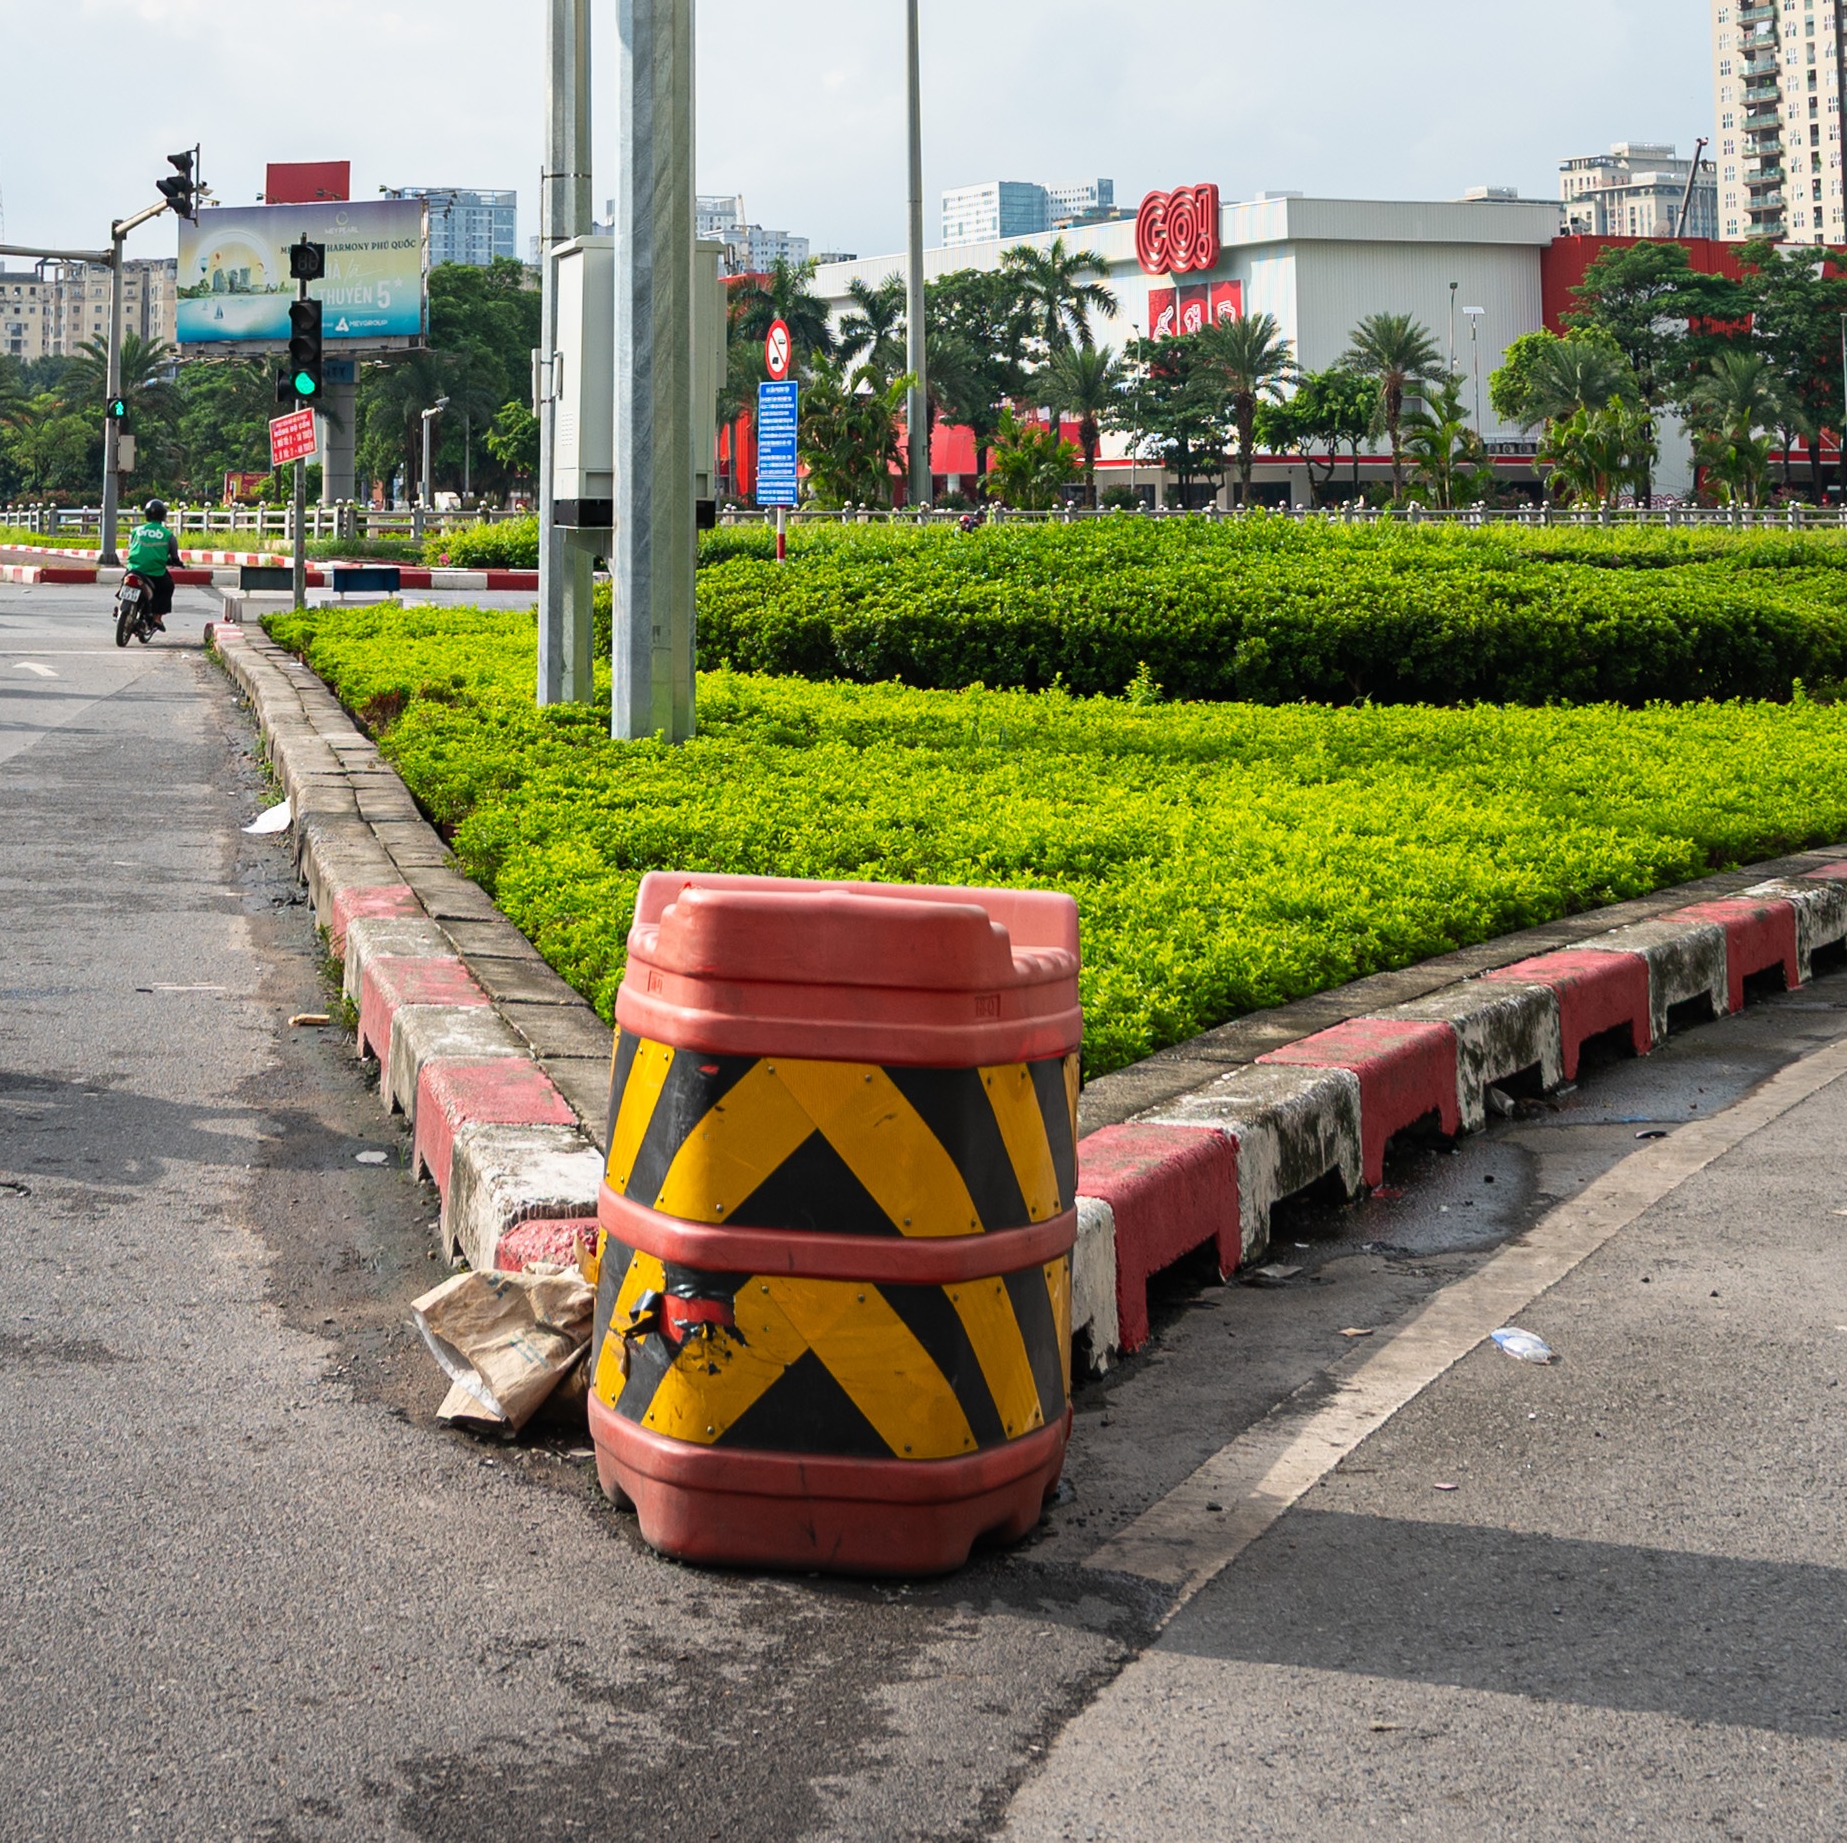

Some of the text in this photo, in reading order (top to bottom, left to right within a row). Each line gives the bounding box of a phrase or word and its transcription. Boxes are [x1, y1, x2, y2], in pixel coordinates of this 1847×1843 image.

[1135, 183, 1220, 275] GO!
[327, 238, 416, 252] HARMONY PHÚ QUỐC
[325, 258, 341, 280] HÀ
[136, 528, 164, 539] Grab
